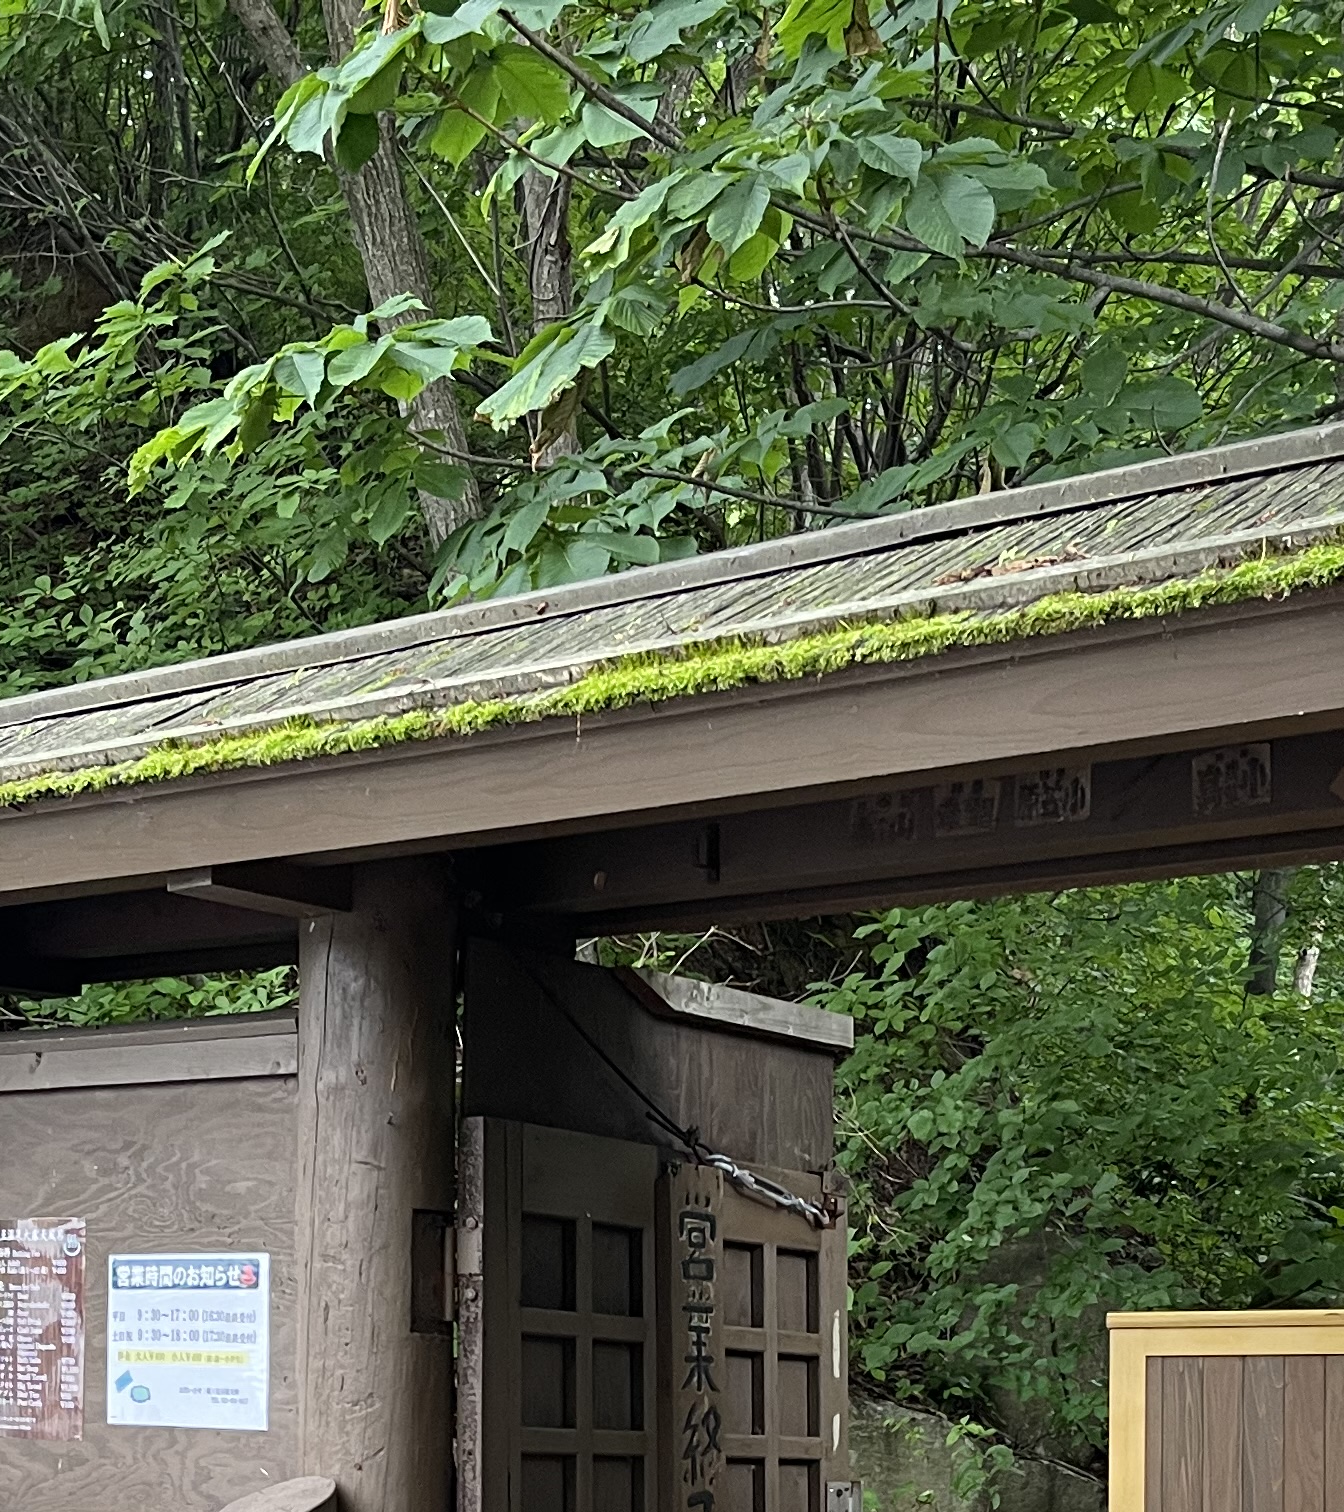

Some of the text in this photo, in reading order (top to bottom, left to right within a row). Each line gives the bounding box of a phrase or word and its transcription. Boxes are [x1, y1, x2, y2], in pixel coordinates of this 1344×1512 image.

[116, 1265, 243, 1288] 営業時間のお知らせ
